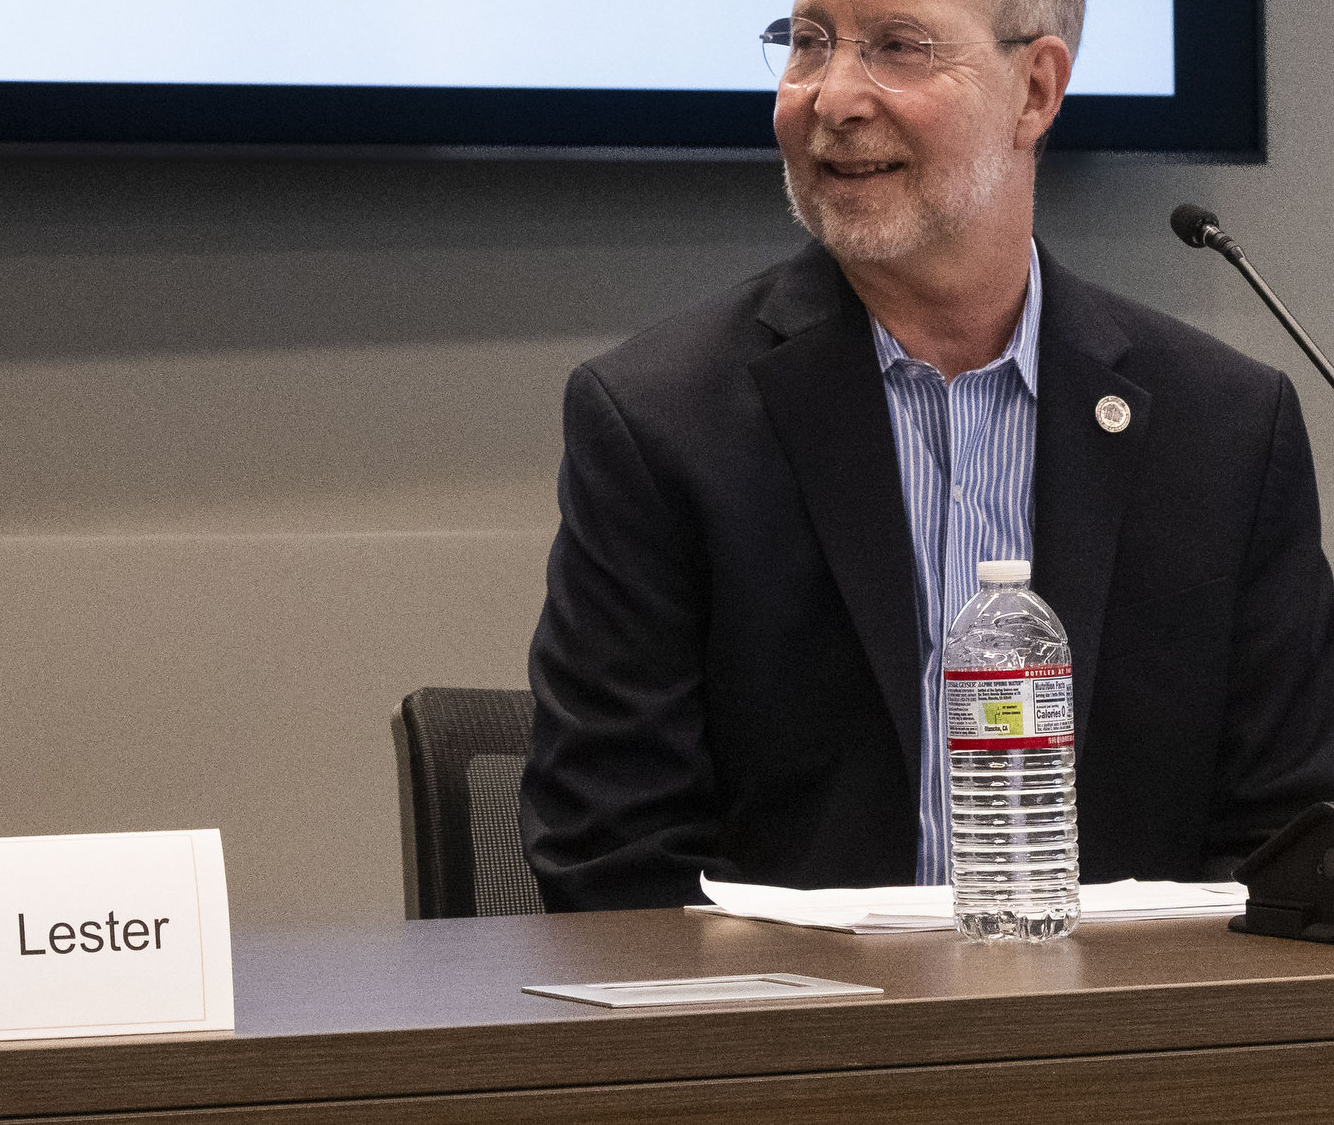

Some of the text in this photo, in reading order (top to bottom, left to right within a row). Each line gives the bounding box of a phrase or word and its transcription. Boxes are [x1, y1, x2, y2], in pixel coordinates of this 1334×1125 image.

[1024, 669, 1055, 678] BOTTLED
[1036, 705, 1066, 719] Calories 0
[17, 909, 170, 956] Lester
